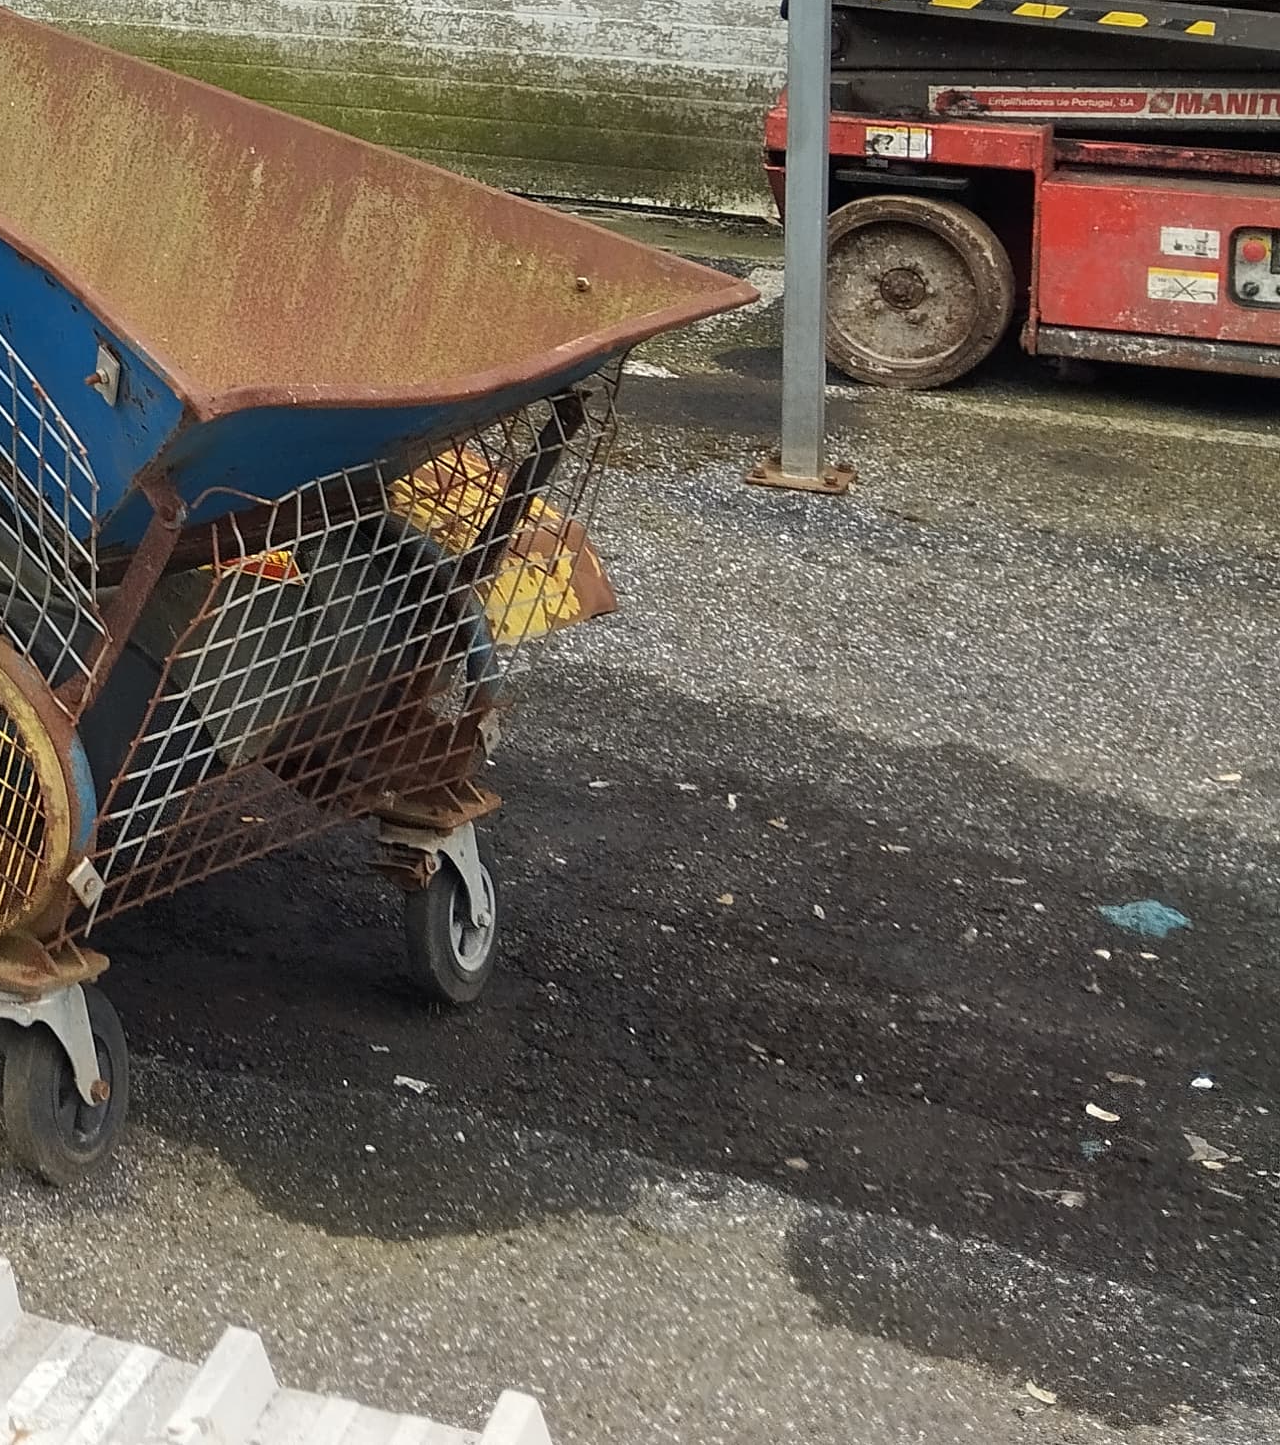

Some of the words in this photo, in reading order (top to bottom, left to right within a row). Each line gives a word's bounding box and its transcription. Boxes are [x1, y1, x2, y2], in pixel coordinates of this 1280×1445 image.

[988, 96, 1055, 108] Empilhadores
[1056, 97, 1070, 106] de
[1175, 93, 1280, 114] MANIT
